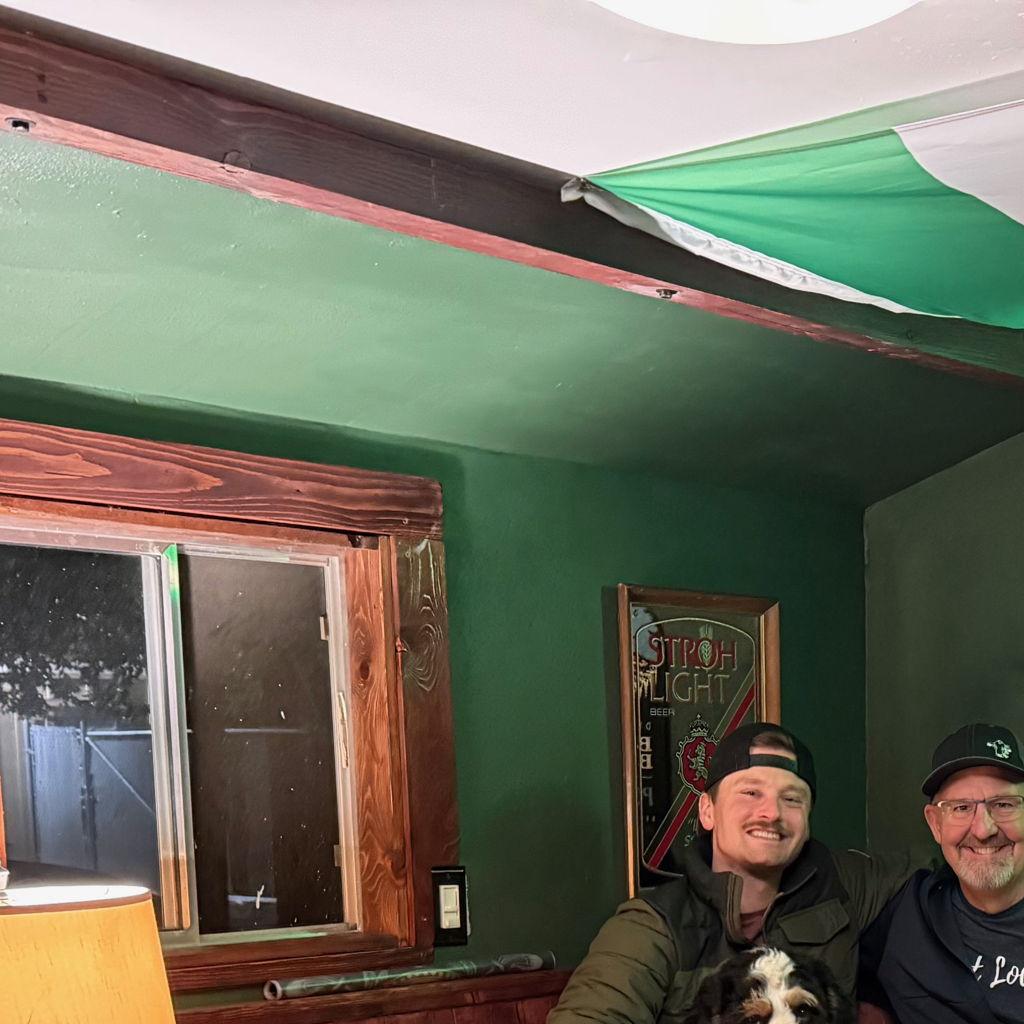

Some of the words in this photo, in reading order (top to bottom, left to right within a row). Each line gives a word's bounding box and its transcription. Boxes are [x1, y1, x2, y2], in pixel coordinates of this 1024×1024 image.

[649, 636, 738, 670] STROH
[650, 672, 730, 704] LIGHT
[650, 707, 675, 716] BEER
